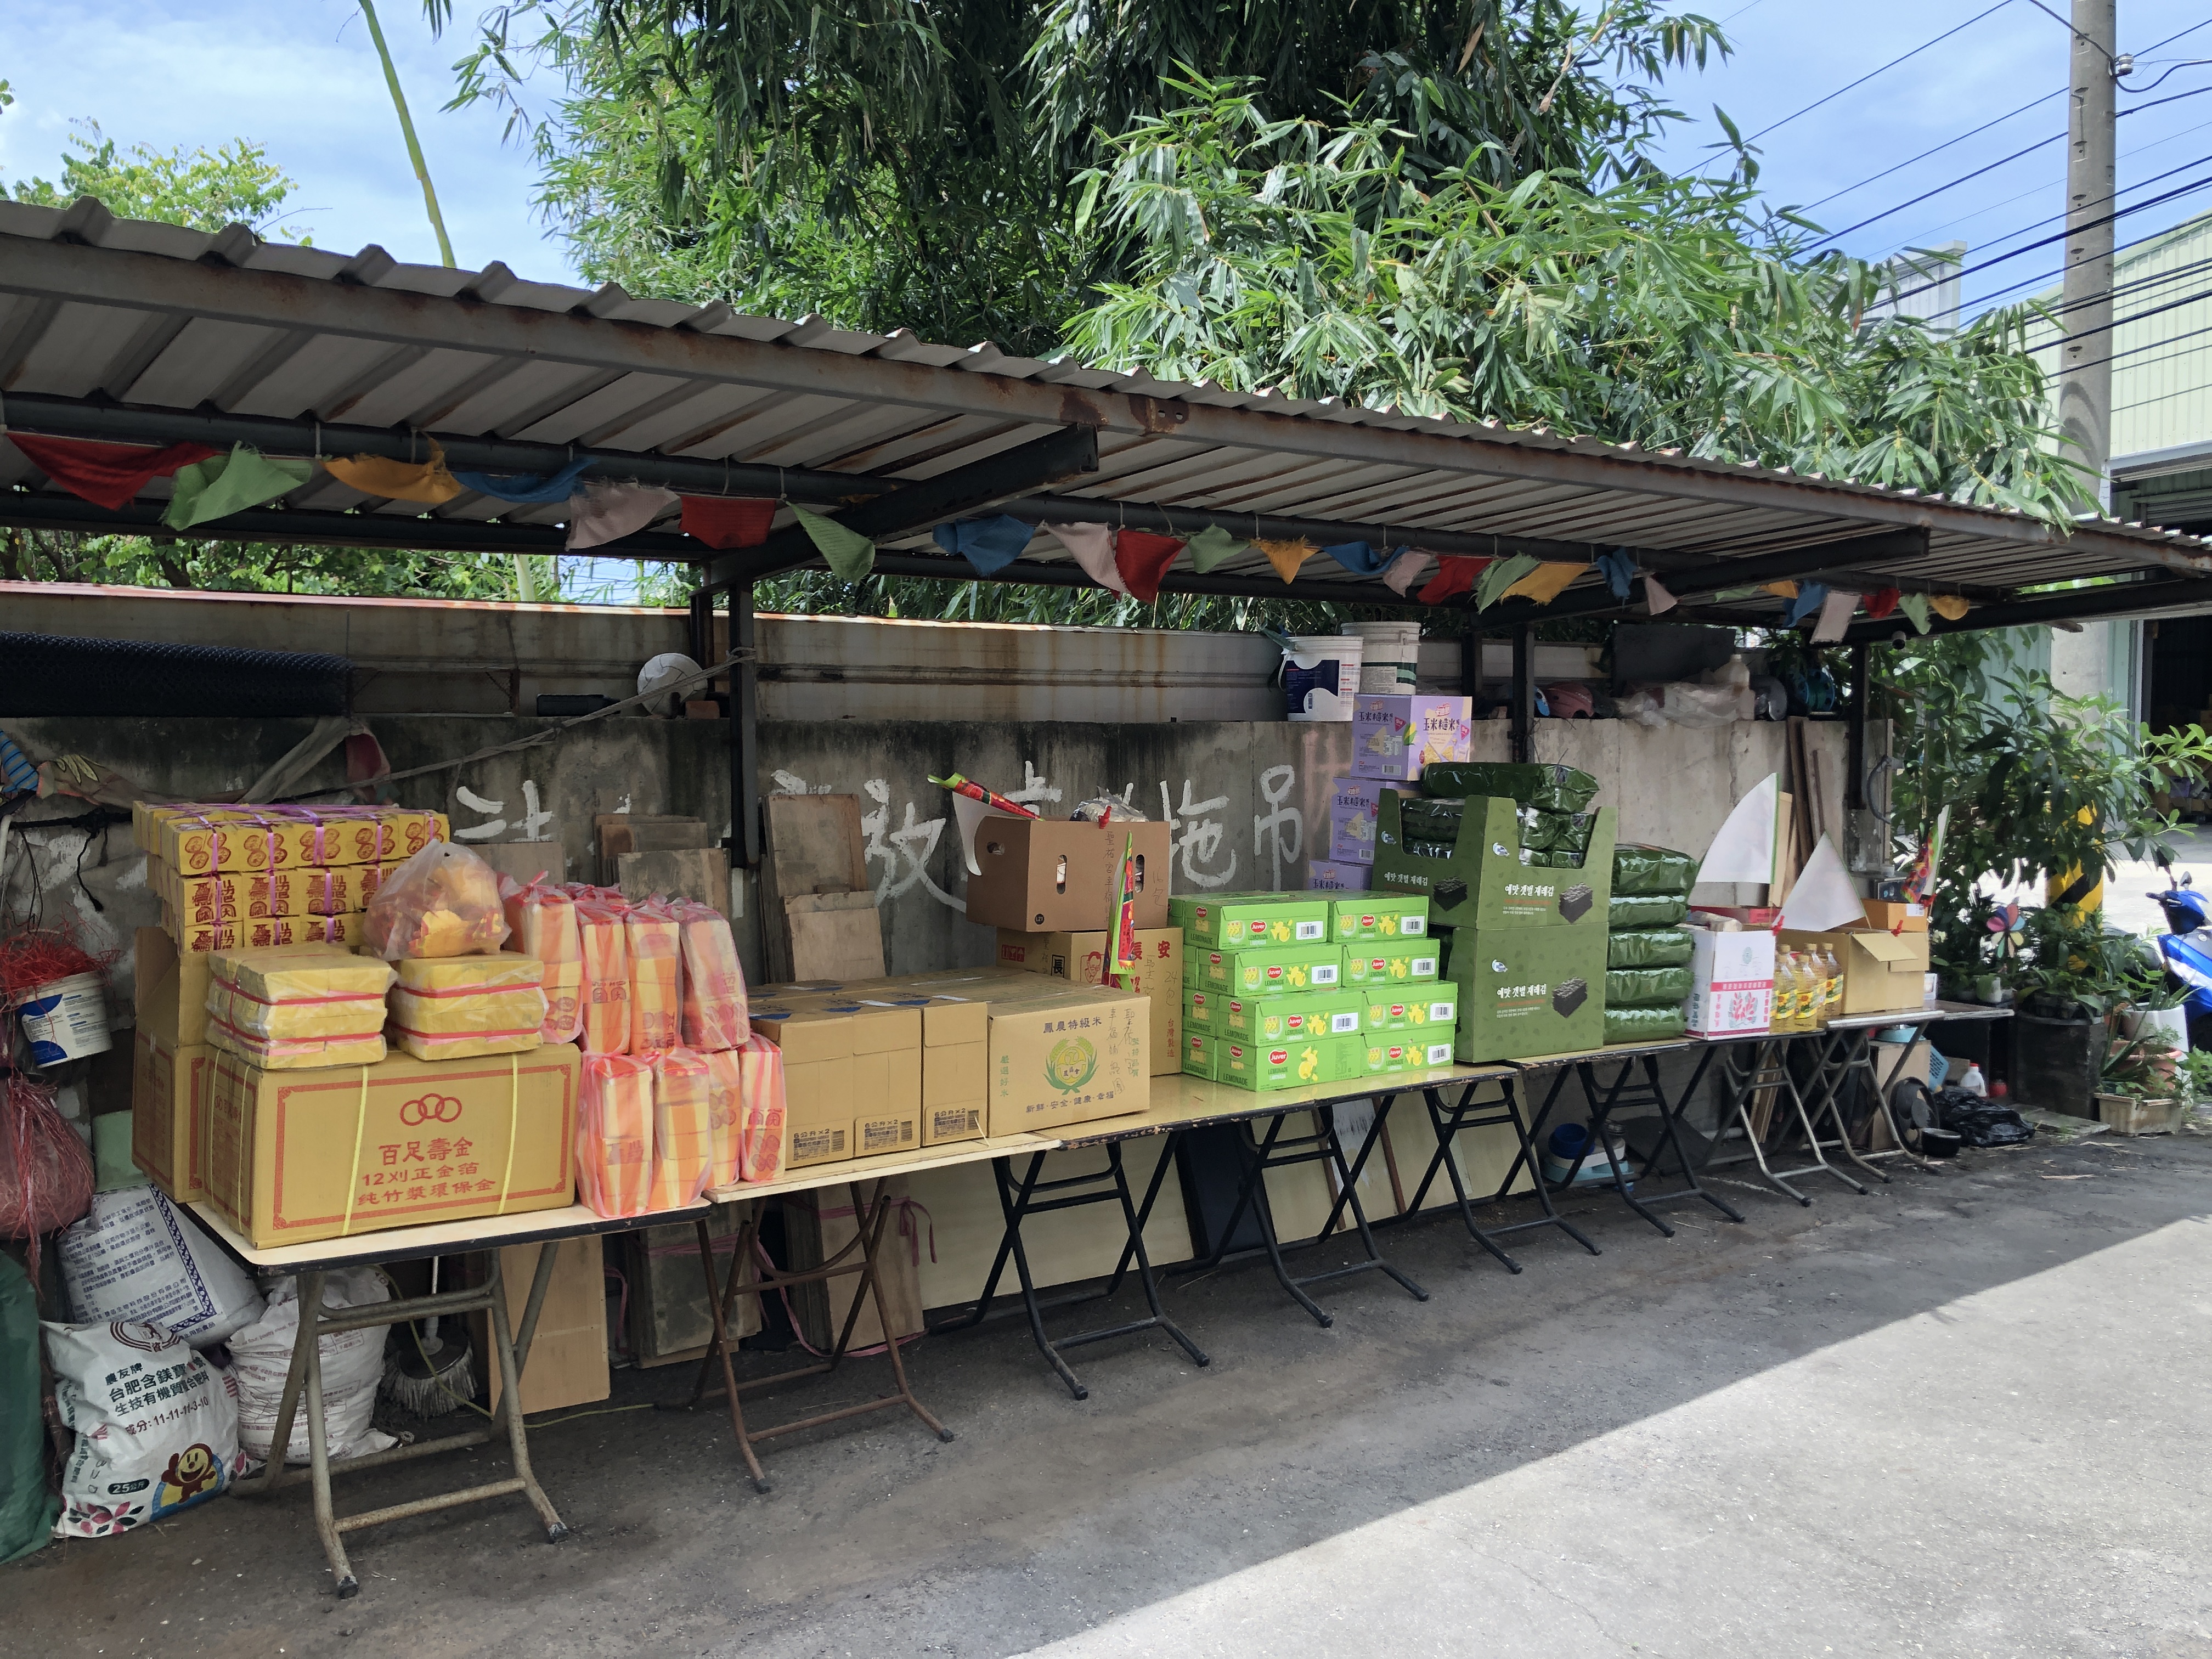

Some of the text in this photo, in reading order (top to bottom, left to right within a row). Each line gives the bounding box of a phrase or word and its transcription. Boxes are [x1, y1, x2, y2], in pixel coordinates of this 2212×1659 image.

[1190, 933, 1213, 945] LEMONADE
[1053, 958, 1063, 974] 長
[1204, 979, 1228, 992] LEMONADE
[1043, 1016, 1102, 1034] 鳳農特級米
[1187, 1020, 1211, 1033] LEMONADE
[1167, 1018, 1175, 1058] 台灣製造
[1224, 1029, 1249, 1042] LEMONADE
[1184, 1062, 1207, 1075] LEMONADE
[1268, 1066, 1288, 1075] LEMONADE
[1223, 1073, 1248, 1086] LEMONADE
[379, 1136, 473, 1166] 百足壽金
